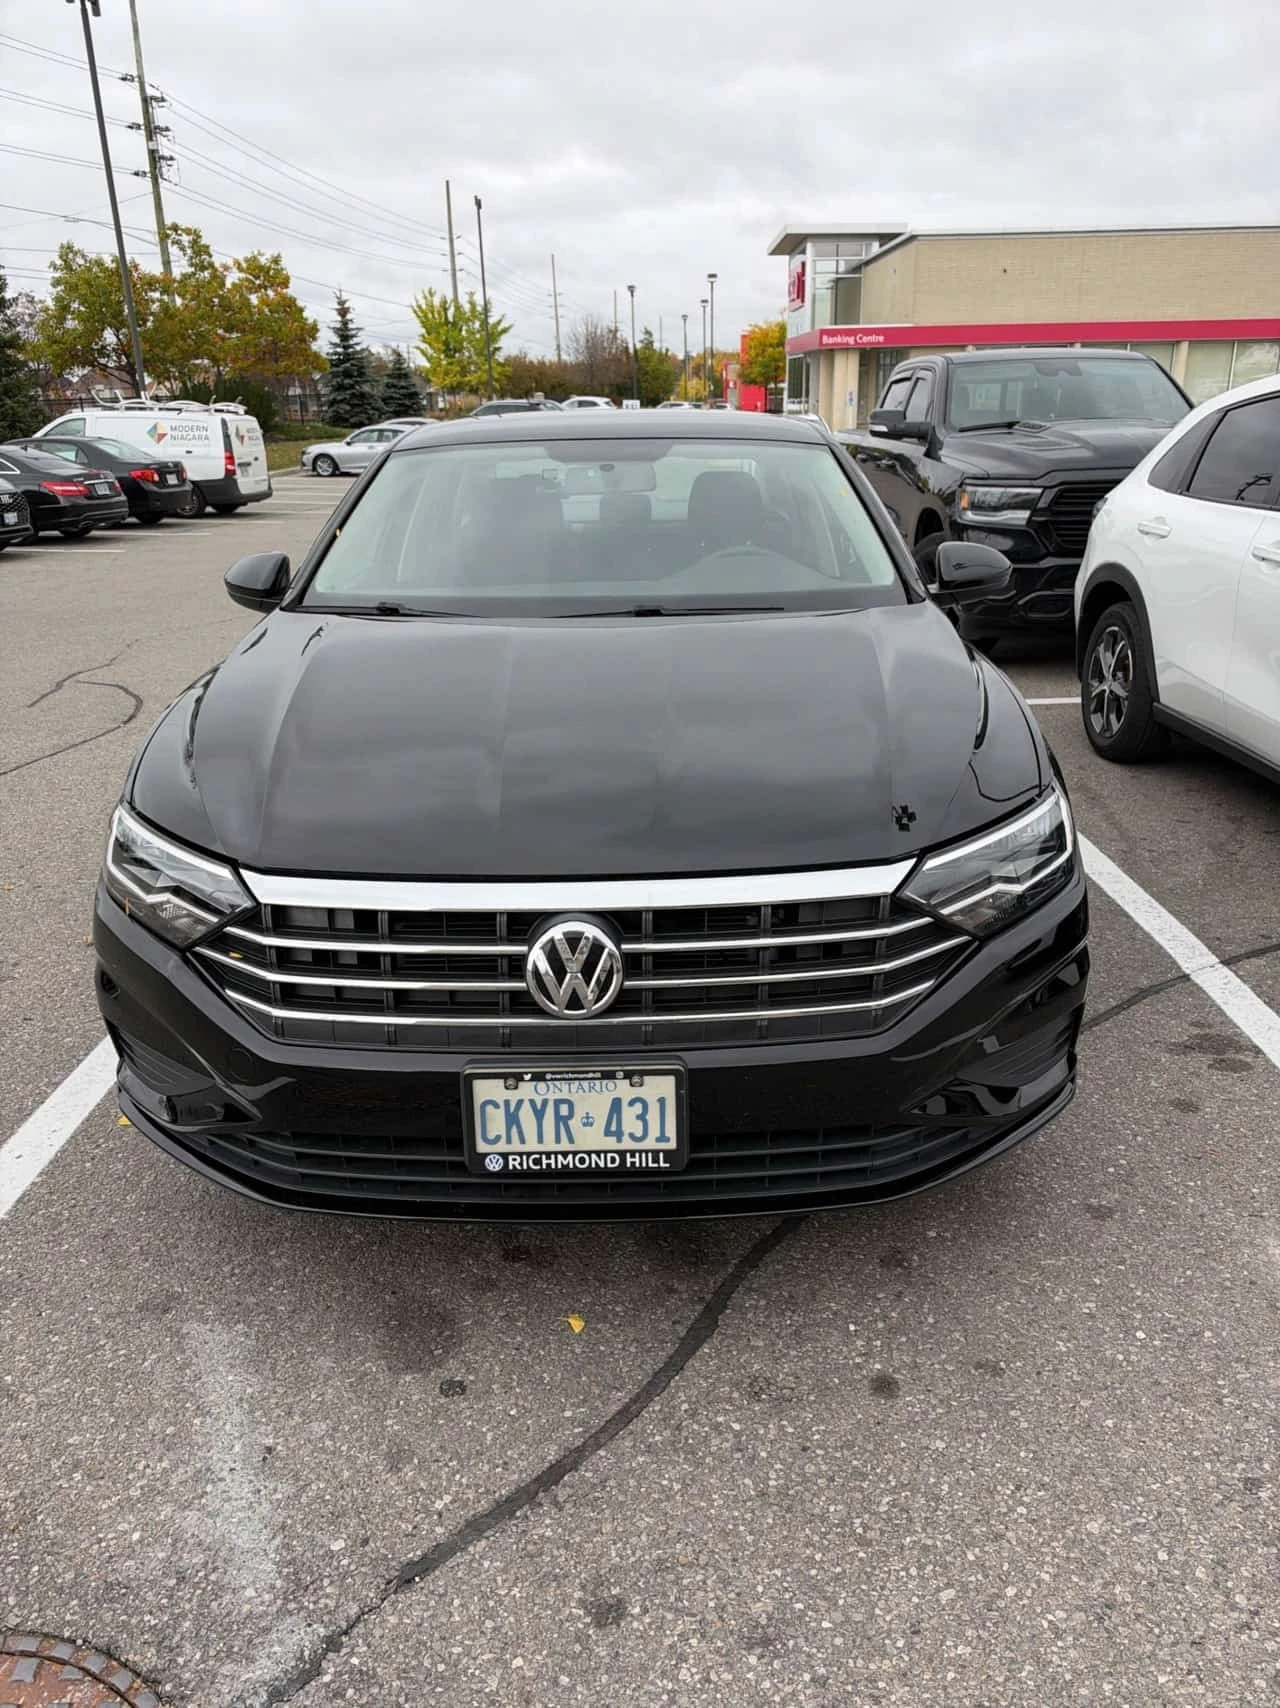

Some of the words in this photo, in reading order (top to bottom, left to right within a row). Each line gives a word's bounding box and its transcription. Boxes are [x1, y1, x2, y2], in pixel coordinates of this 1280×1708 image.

[822, 334, 855, 345] Banking
[856, 333, 885, 344] Centre
[170, 424, 209, 433] MODERN
[170, 433, 210, 441] NIAGARA
[479, 1098, 575, 1146] CKYR
[603, 1096, 671, 1144] 431
[508, 1153, 620, 1170] RICHMOND
[626, 1152, 670, 1168] HILL
